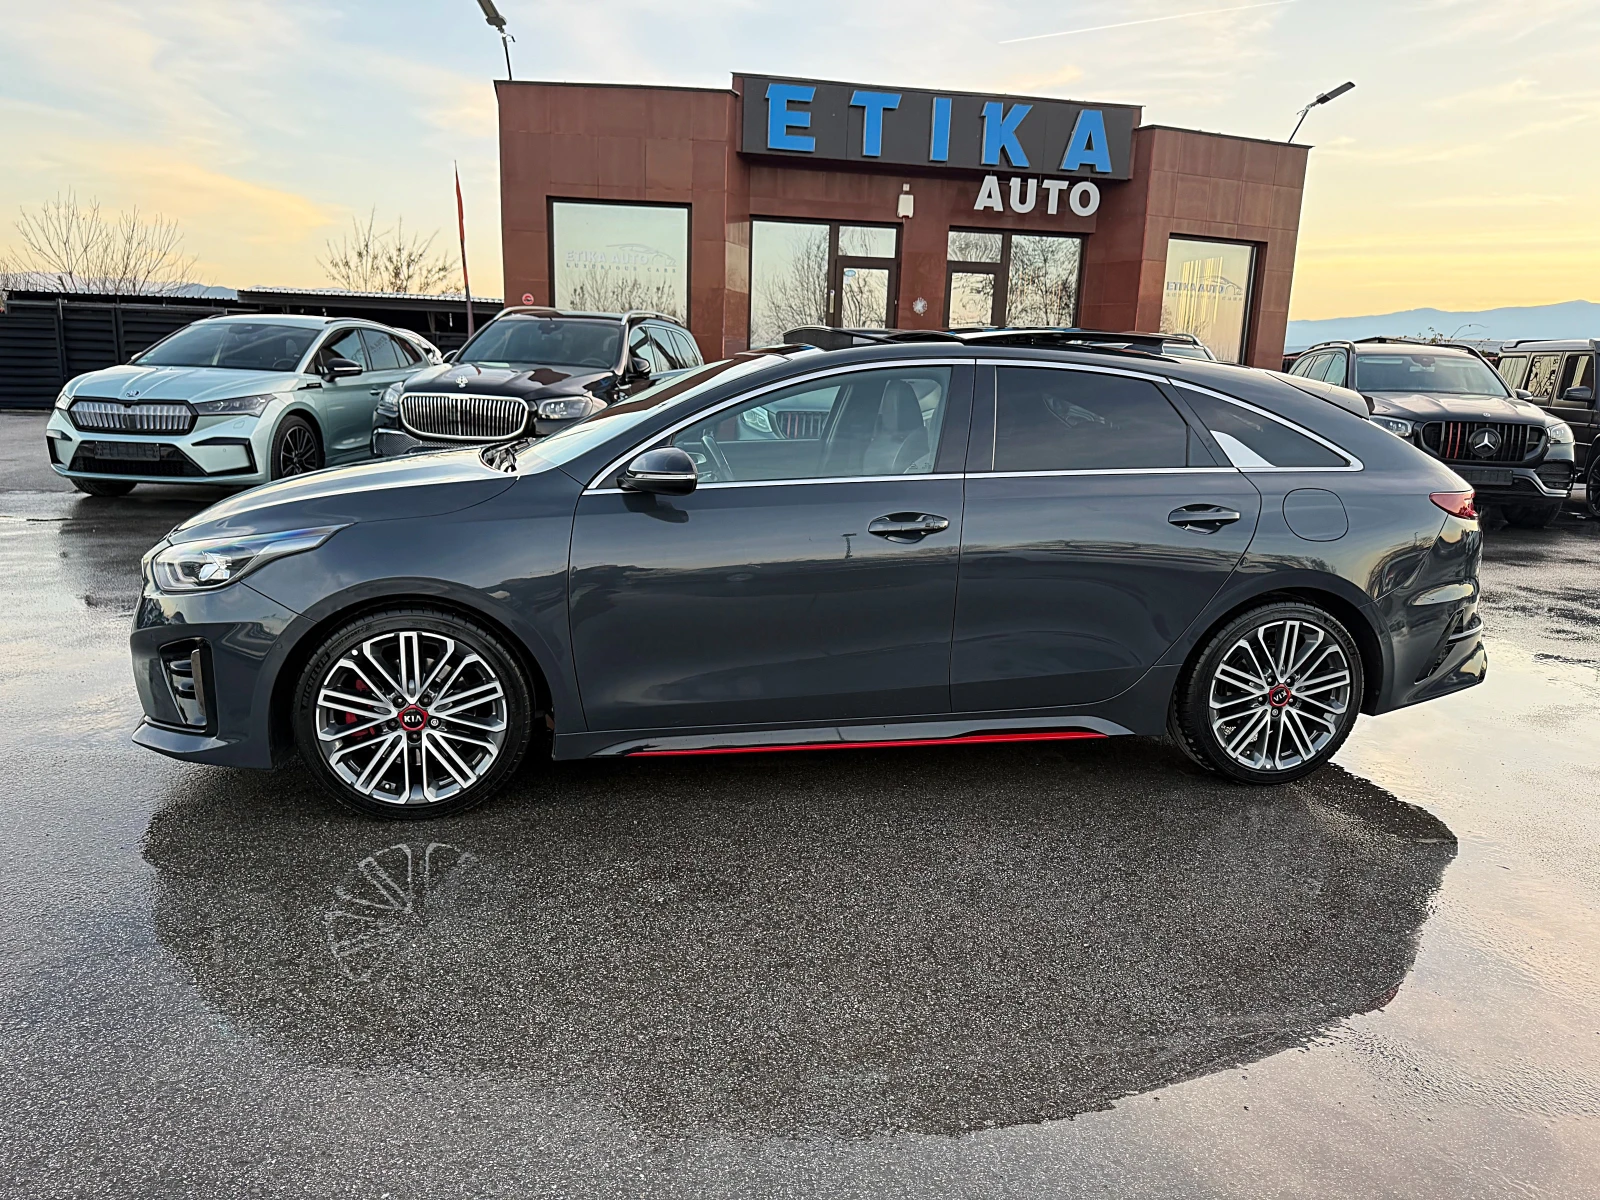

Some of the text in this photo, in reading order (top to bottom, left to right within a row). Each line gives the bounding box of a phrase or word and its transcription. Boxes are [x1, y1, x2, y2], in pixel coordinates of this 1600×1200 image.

[765, 83, 1112, 173] ETIKA
[974, 175, 1100, 216] AUTO
[566, 250, 650, 265] ETIKA AUTO
[1166, 281, 1225, 294] ETIKA AUTO
[302, 653, 330, 708] MICHELIN
[1273, 690, 1288, 702] KIA
[403, 715, 422, 723] KIA
